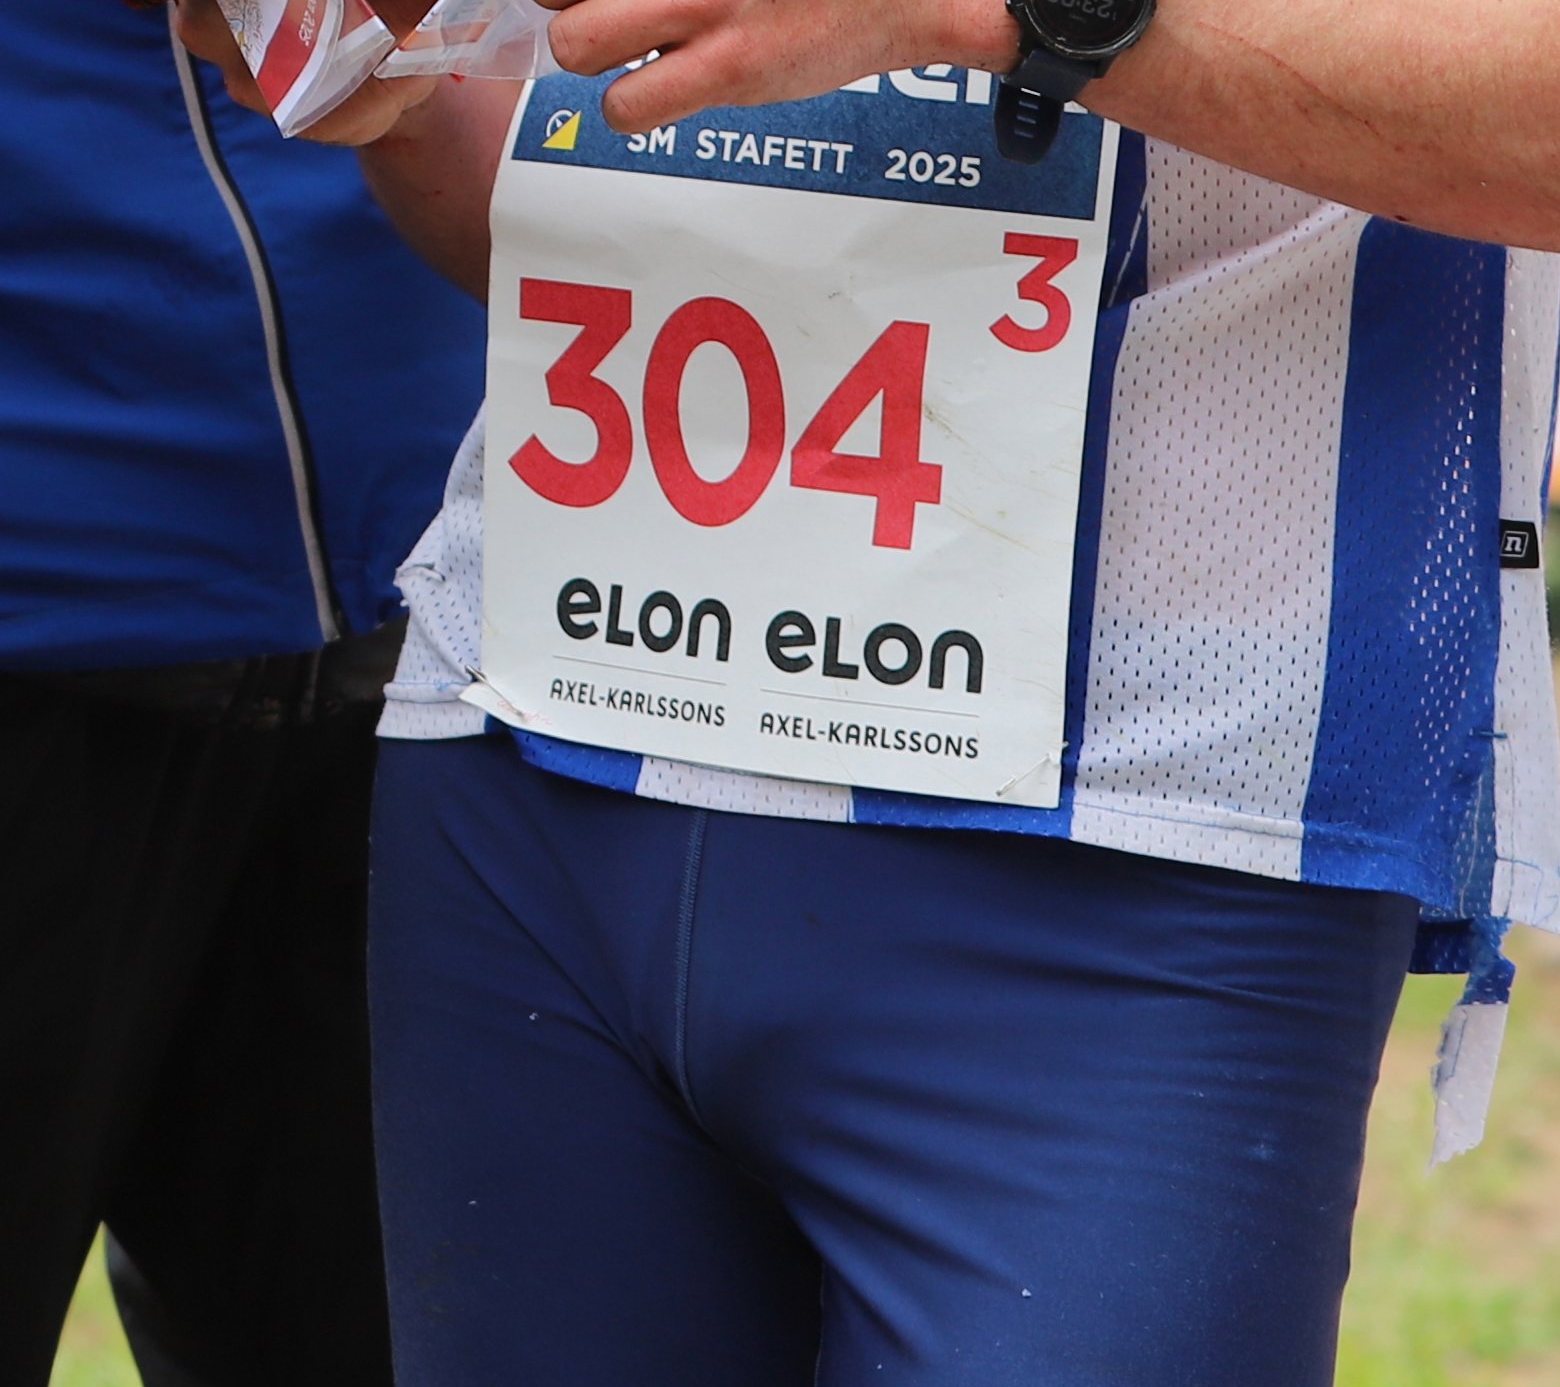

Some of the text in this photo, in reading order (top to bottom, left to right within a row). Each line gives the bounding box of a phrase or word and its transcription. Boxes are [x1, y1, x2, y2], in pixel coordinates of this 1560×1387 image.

[626, 124, 981, 188] SM STAFETT 2025
[988, 231, 1079, 354] 3
[506, 277, 943, 552] 304
[549, 678, 726, 728] AXEL-KARLSSONS
[759, 712, 980, 760] AXEL-KARLSSONS
